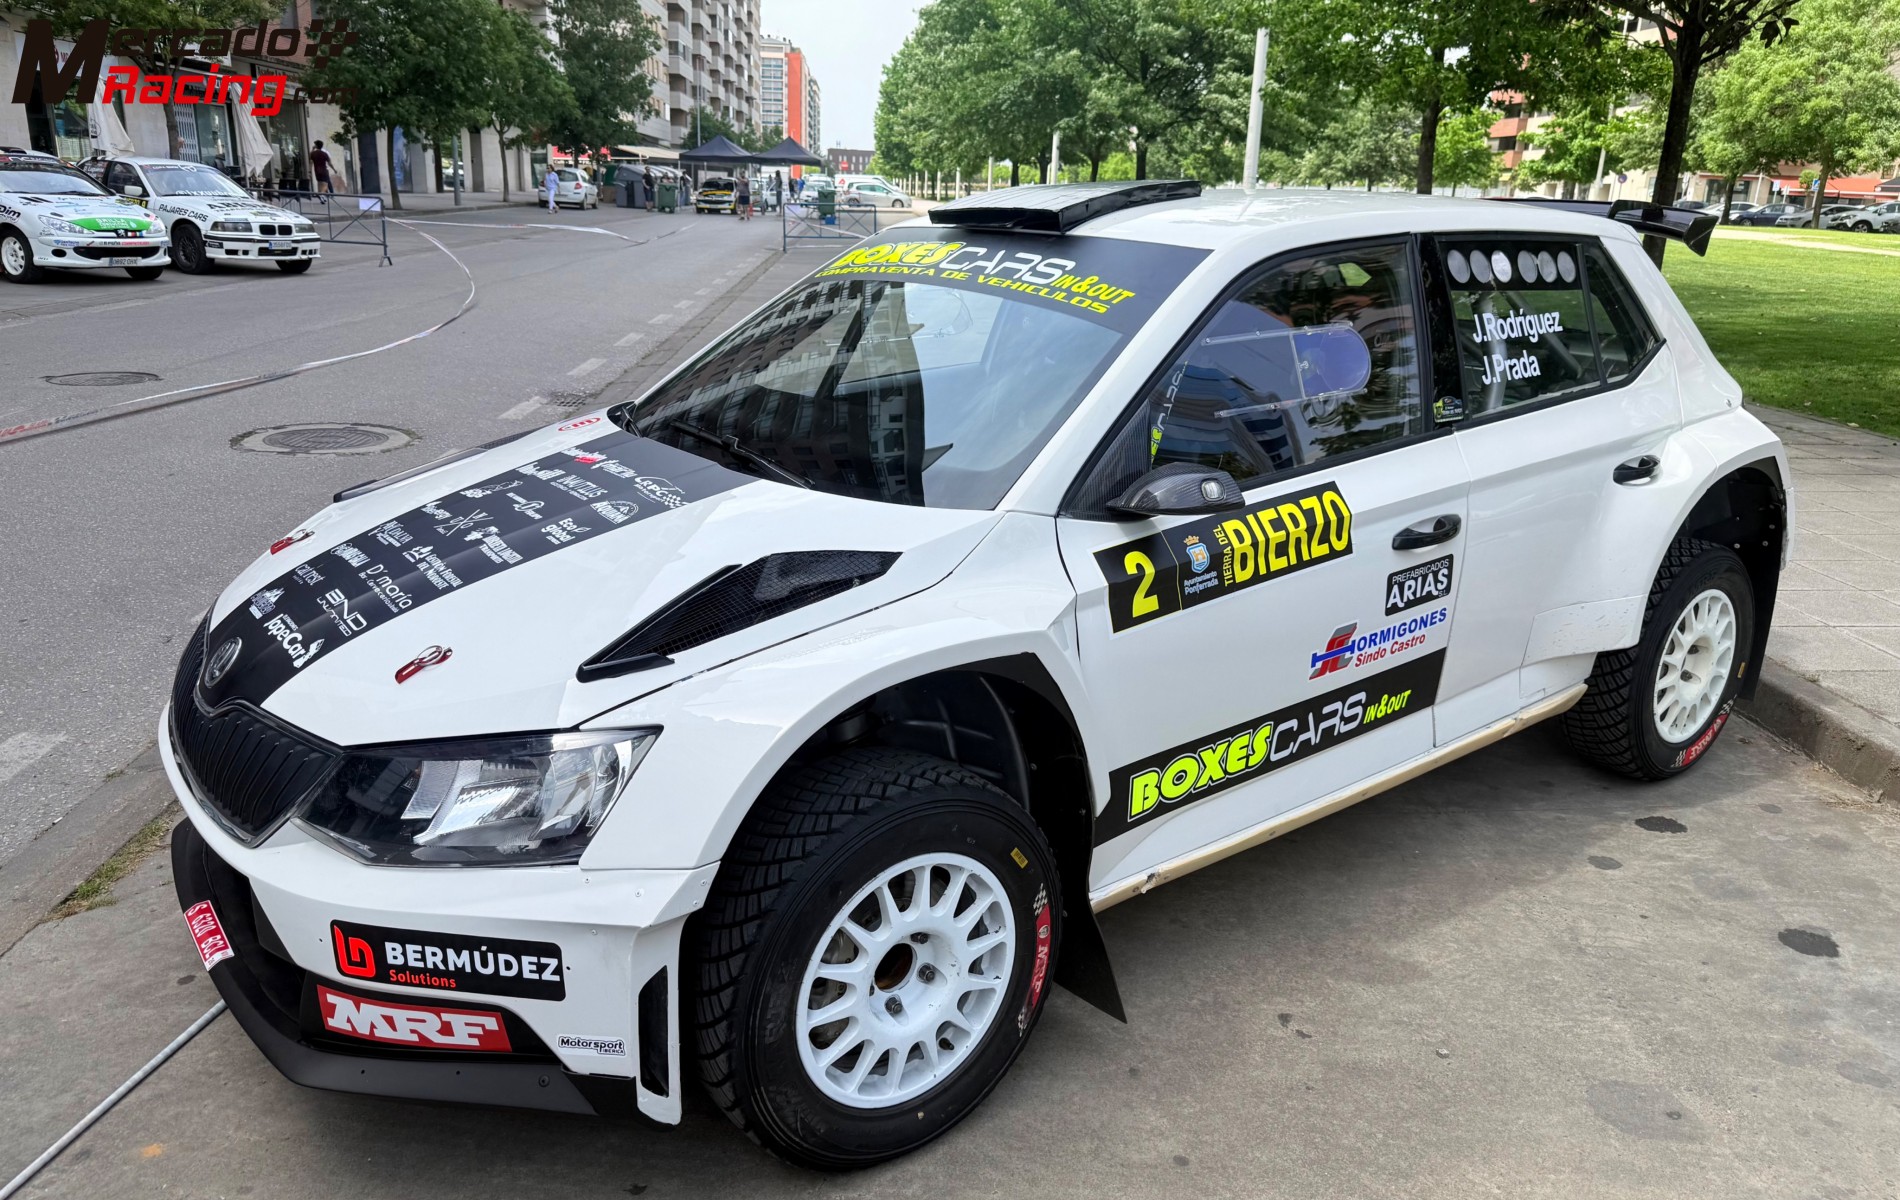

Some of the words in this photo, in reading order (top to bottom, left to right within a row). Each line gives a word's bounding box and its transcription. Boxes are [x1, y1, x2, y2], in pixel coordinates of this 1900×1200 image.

[158, 203, 189, 215] PAJARES
[188, 210, 209, 222] CARS
[824, 241, 967, 271] BOXES
[938, 246, 1076, 286] CARS
[1051, 275, 1135, 305] IN&OUT
[814, 266, 935, 278] COMPRAVENTA
[940, 270, 972, 281] DE
[977, 275, 1111, 314] VEHICULOS
[1473, 308, 1563, 343] J.Rodríguez
[1481, 349, 1541, 385] J.Prada
[541, 524, 576, 543] global
[558, 517, 578, 533] Eco
[1212, 524, 1229, 546] DEL
[1221, 490, 1352, 584] BIERZO
[1183, 570, 1218, 587] Ayuntamiento
[1222, 545, 1234, 587] TIERRA
[1391, 558, 1450, 585] PREFABRICADOS
[1123, 550, 1159, 619] 2
[1184, 578, 1219, 595] Ponferrada
[1386, 568, 1449, 609] ARIAS
[1354, 646, 1387, 668] Sindo
[1390, 633, 1426, 655] Castro
[1127, 721, 1274, 823] BOXES
[1268, 691, 1367, 763] CARS
[1362, 689, 1412, 725] IN&OUT
[187, 903, 208, 917] S
[191, 912, 217, 938] 6320
[200, 934, 226, 959] BCL
[384, 941, 561, 982] BERMÚDEZ
[389, 969, 457, 989] Solutions
[325, 993, 499, 1047] MRF
[560, 1038, 623, 1053] Motorsport
